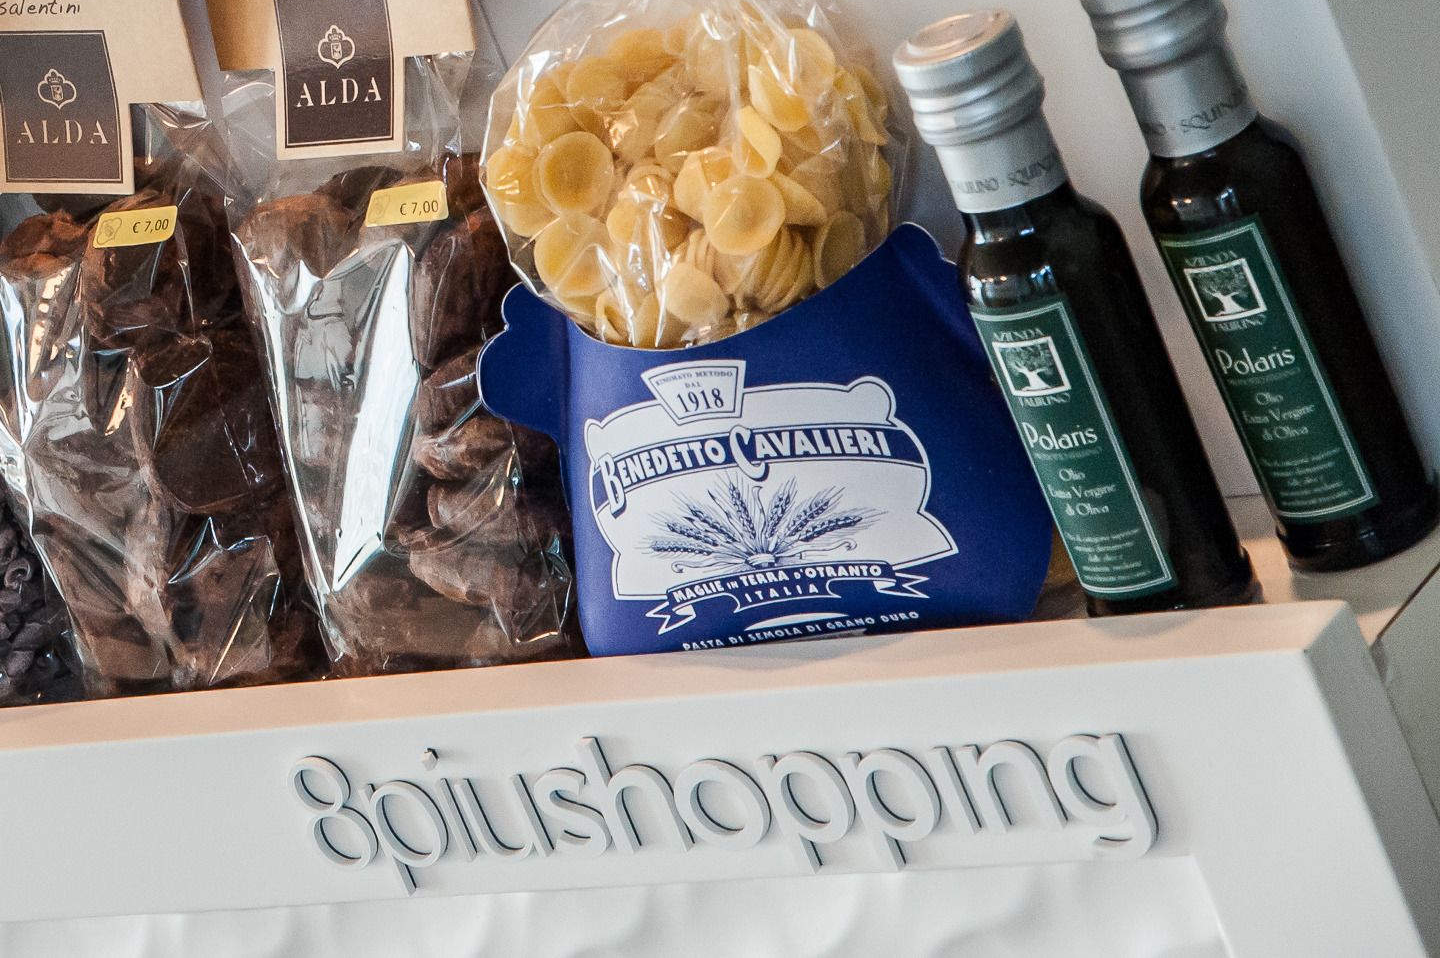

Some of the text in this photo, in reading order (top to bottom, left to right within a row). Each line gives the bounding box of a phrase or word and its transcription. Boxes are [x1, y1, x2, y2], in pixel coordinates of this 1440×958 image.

[296, 76, 382, 108] ALDA
[17, 119, 111, 144] ALDA
[400, 200, 438, 216] € 7,00
[132, 219, 168, 234] € 7,00
[1216, 346, 1296, 375] Polaris
[676, 388, 724, 414] 1918
[1022, 422, 1098, 450] Polaris
[598, 424, 892, 519] BENEDETTO CAVALIERI
[673, 580, 724, 603] MAGLIE
[740, 569, 789, 587] TERRA
[744, 584, 819, 603] ITALIA
[683, 611, 920, 652] PASTA DI SEMOLA DI GRANO DURO
[287, 732, 1162, 896] 8piushopping
